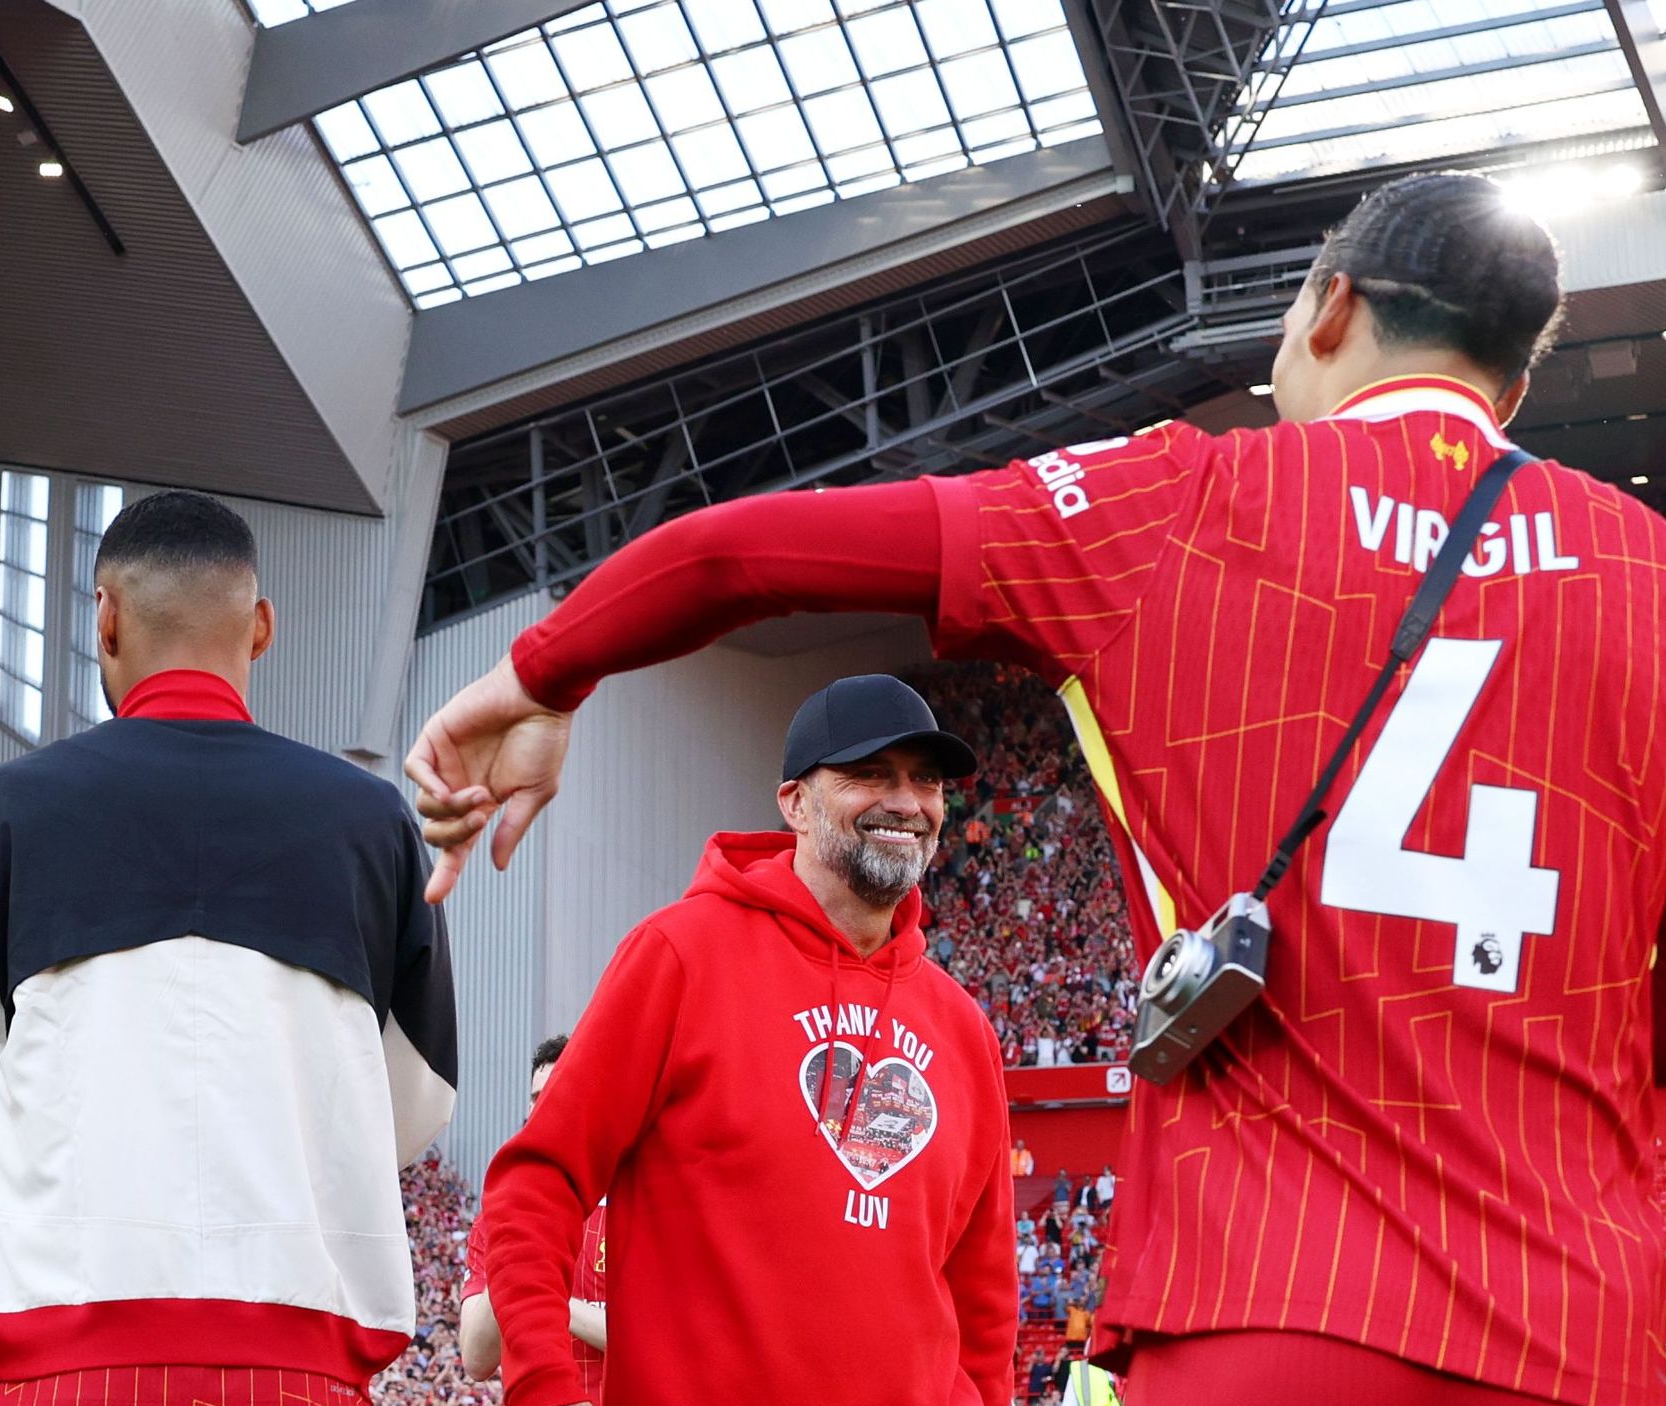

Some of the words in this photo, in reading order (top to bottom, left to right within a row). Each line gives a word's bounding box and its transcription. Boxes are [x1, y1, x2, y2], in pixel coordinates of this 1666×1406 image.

[1350, 485, 1579, 578] VIRGIL
[1320, 637, 1561, 993] 4
[793, 1003, 881, 1043] THANK
[892, 1018, 934, 1072] YOU
[844, 1189, 889, 1230] LUV
